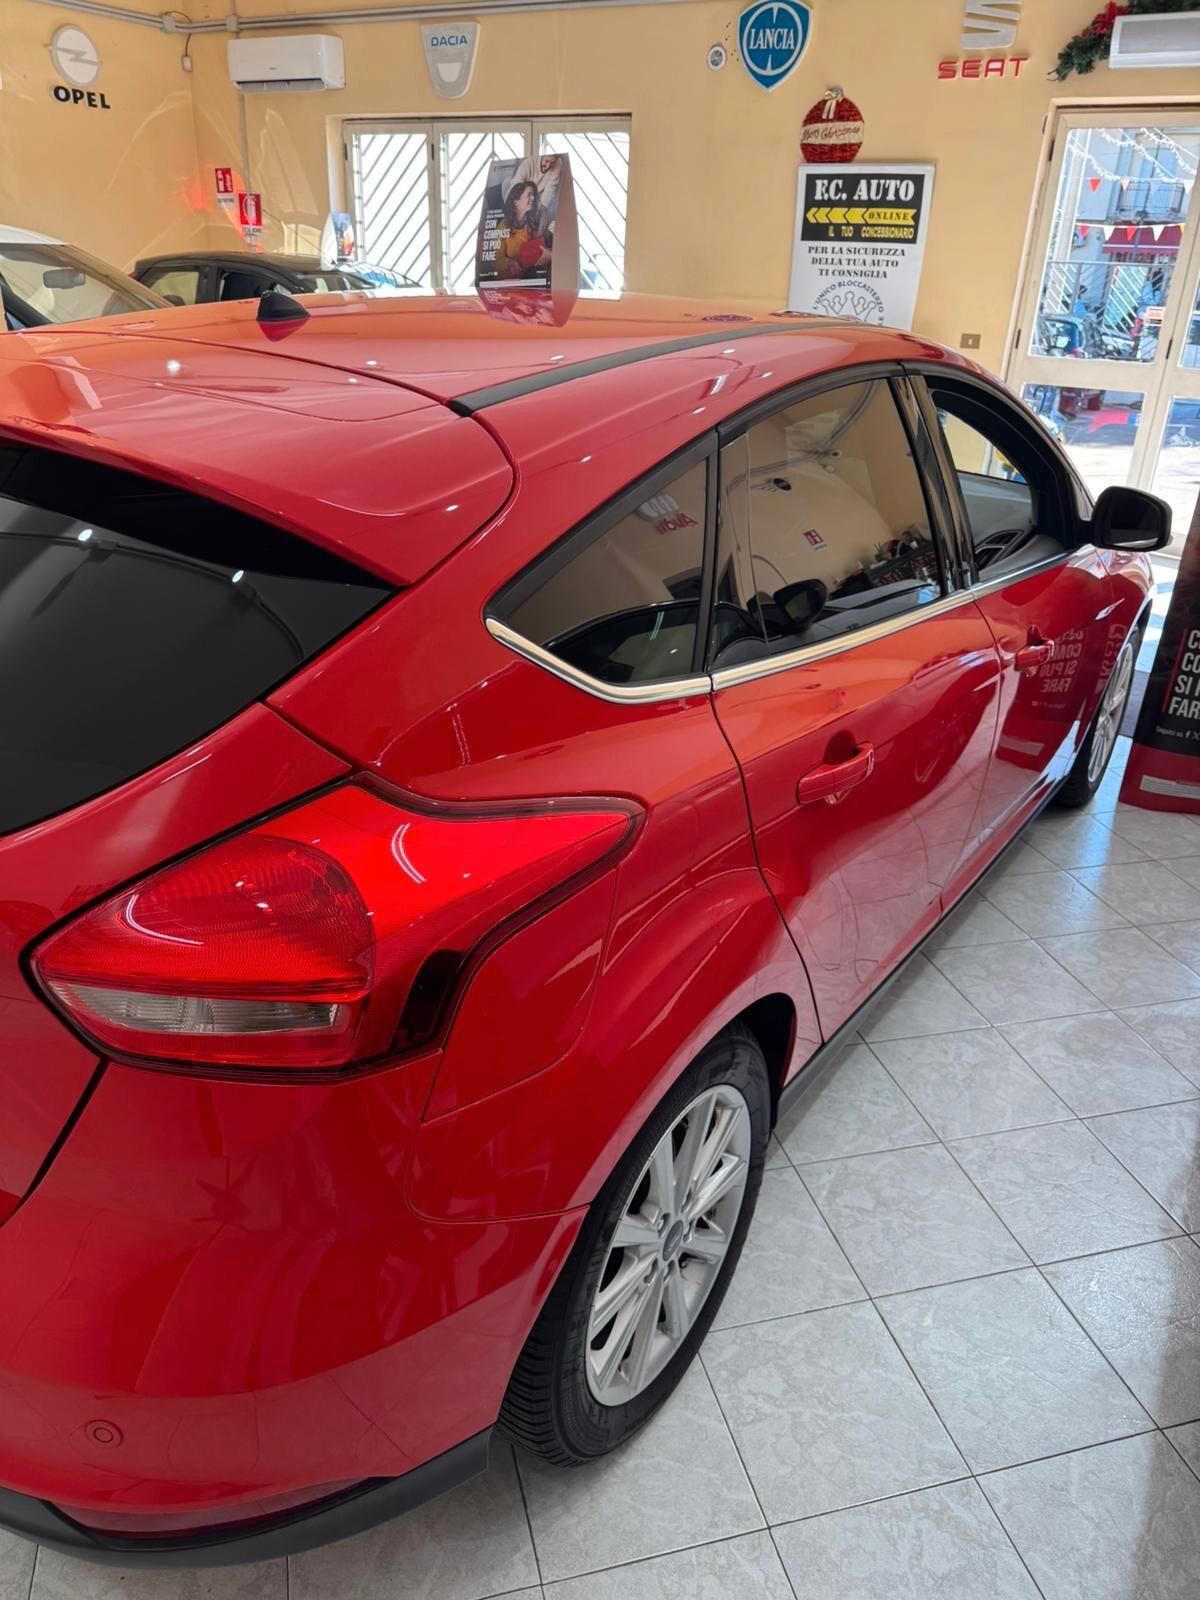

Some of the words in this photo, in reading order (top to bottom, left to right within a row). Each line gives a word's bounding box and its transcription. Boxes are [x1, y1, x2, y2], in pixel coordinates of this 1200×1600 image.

[431, 35, 468, 47] DACIA
[749, 28, 795, 50] LANCIA
[937, 58, 1029, 80] SEAT
[53, 86, 111, 110] OPEL
[853, 179, 915, 201] AUTO
[868, 211, 910, 221] ONLINE
[828, 226, 835, 237] IL
[841, 226, 854, 237] TUO
[861, 226, 914, 239] CONCESSIONARIO
[481, 250, 497, 261] FARE
[808, 246, 828, 255] PER
[831, 246, 844, 255] LA
[846, 247, 906, 257] SICUREZZA
[811, 257, 842, 266] DELLA
[845, 258, 867, 267] TUA
[869, 259, 899, 268] AUTO
[818, 268, 829, 277] TI
[831, 269, 888, 279] CONSIGLIA
[1174, 674, 1194, 695] SI
[1168, 696, 1200, 721] FAR
